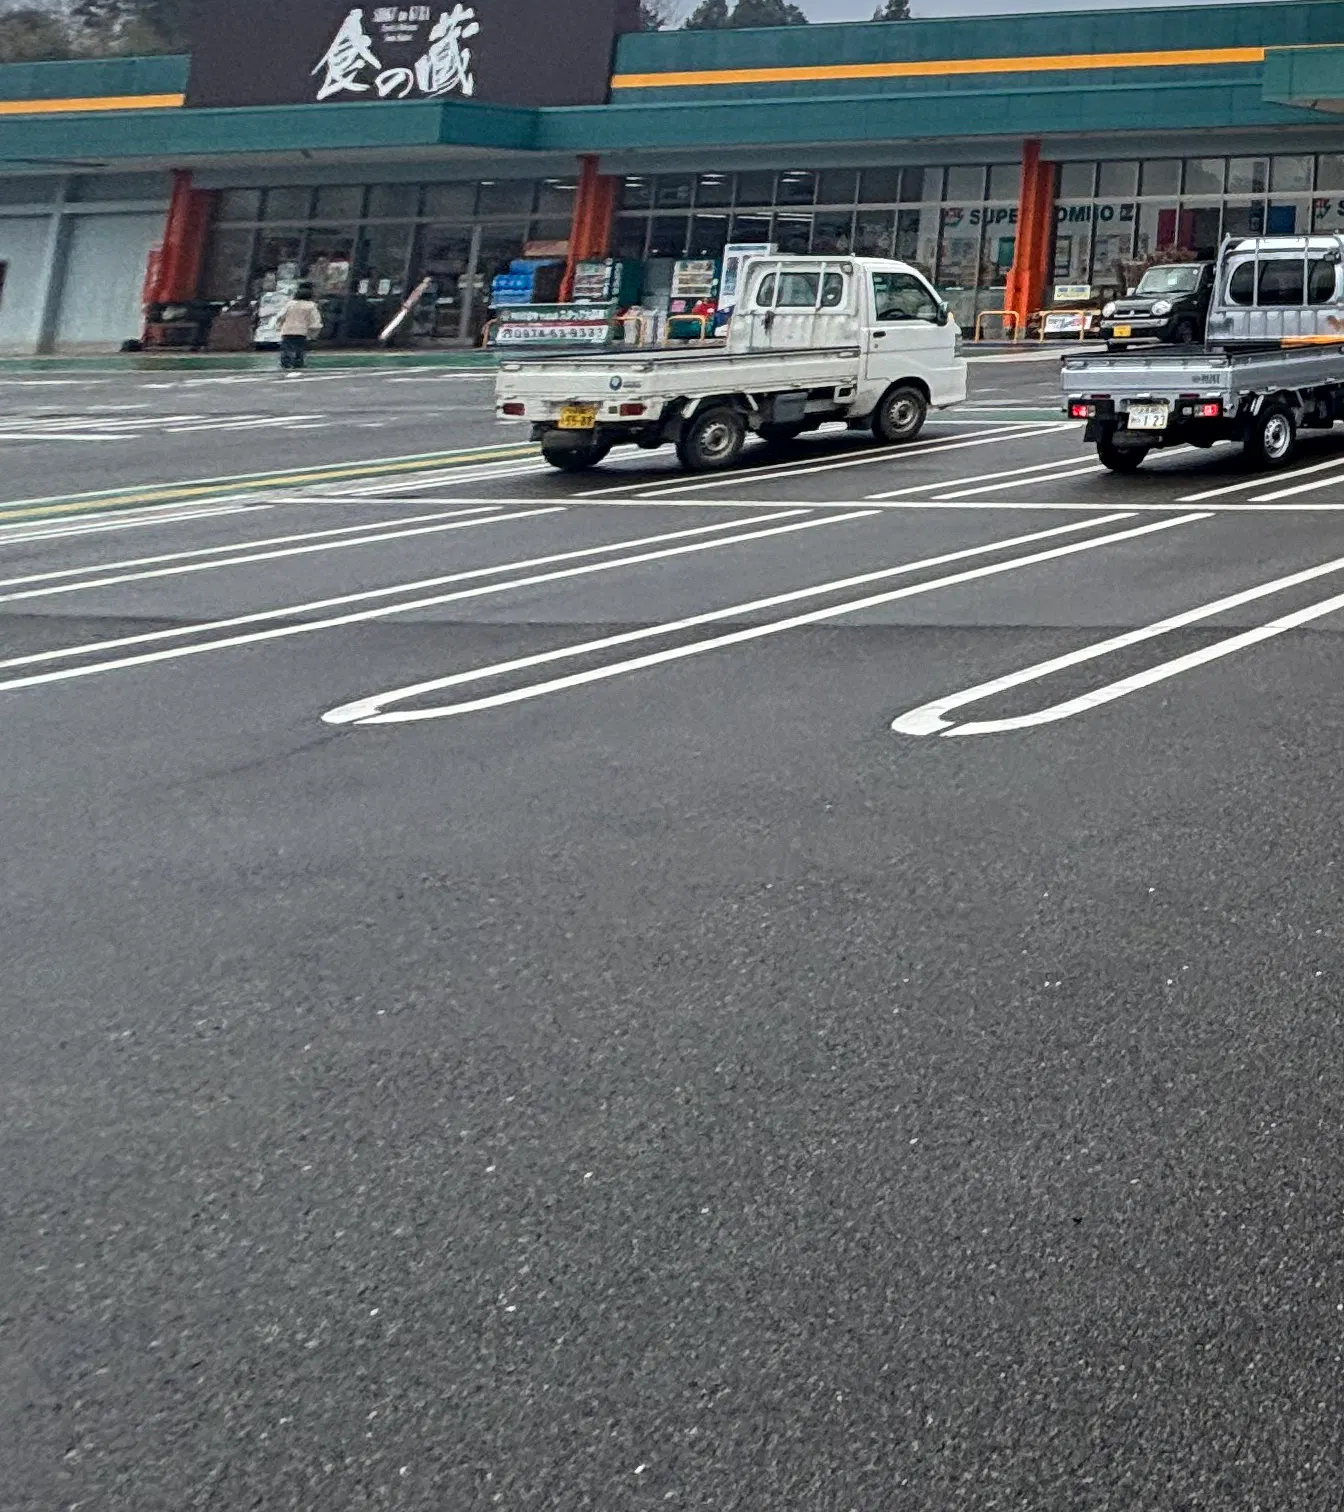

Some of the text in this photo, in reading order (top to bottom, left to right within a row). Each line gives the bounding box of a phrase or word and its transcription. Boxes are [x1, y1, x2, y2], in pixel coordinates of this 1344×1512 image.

[311, 3, 480, 101] 食の蔵
[970, 207, 1019, 225] SUPE
